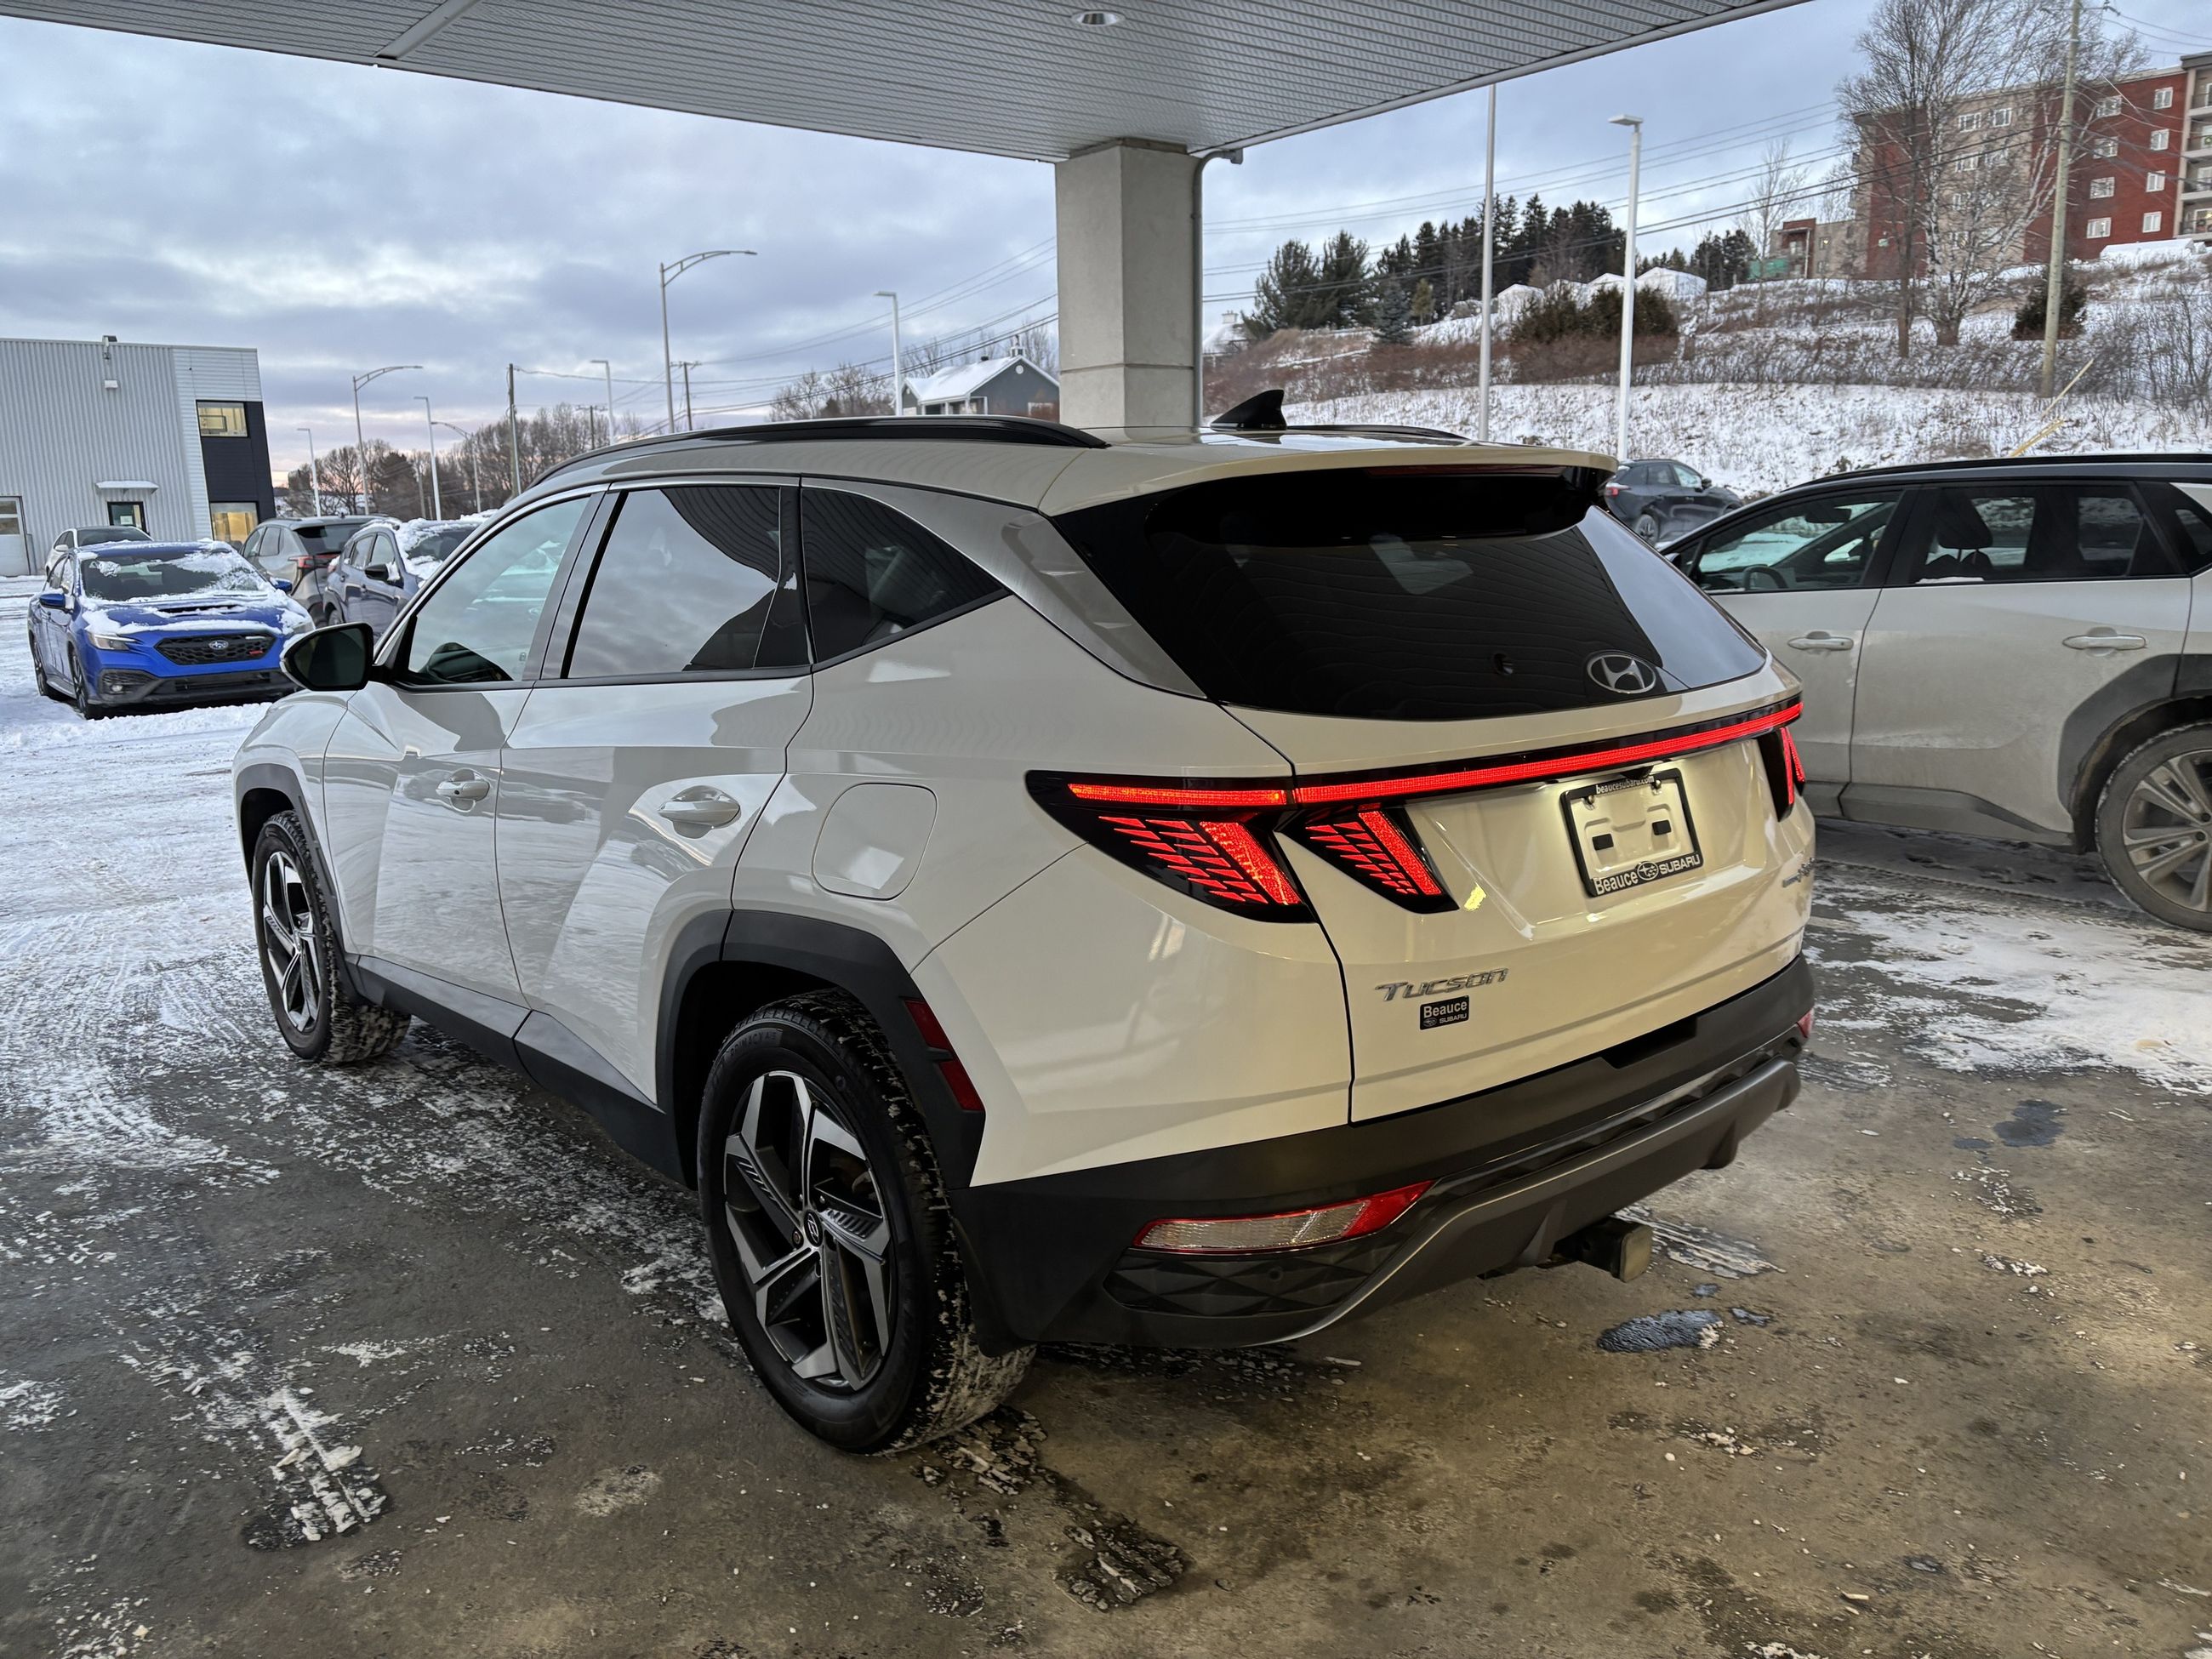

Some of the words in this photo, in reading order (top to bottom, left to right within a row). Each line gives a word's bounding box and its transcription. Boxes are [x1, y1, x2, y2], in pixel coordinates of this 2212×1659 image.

[1596, 776, 1655, 795] beaucesubaru.com
[1593, 871, 1639, 895] Beauce
[1659, 854, 1701, 875] SUBARU
[1423, 1001, 1468, 1018] Beauce
[1440, 1012, 1468, 1023] SUBARU
